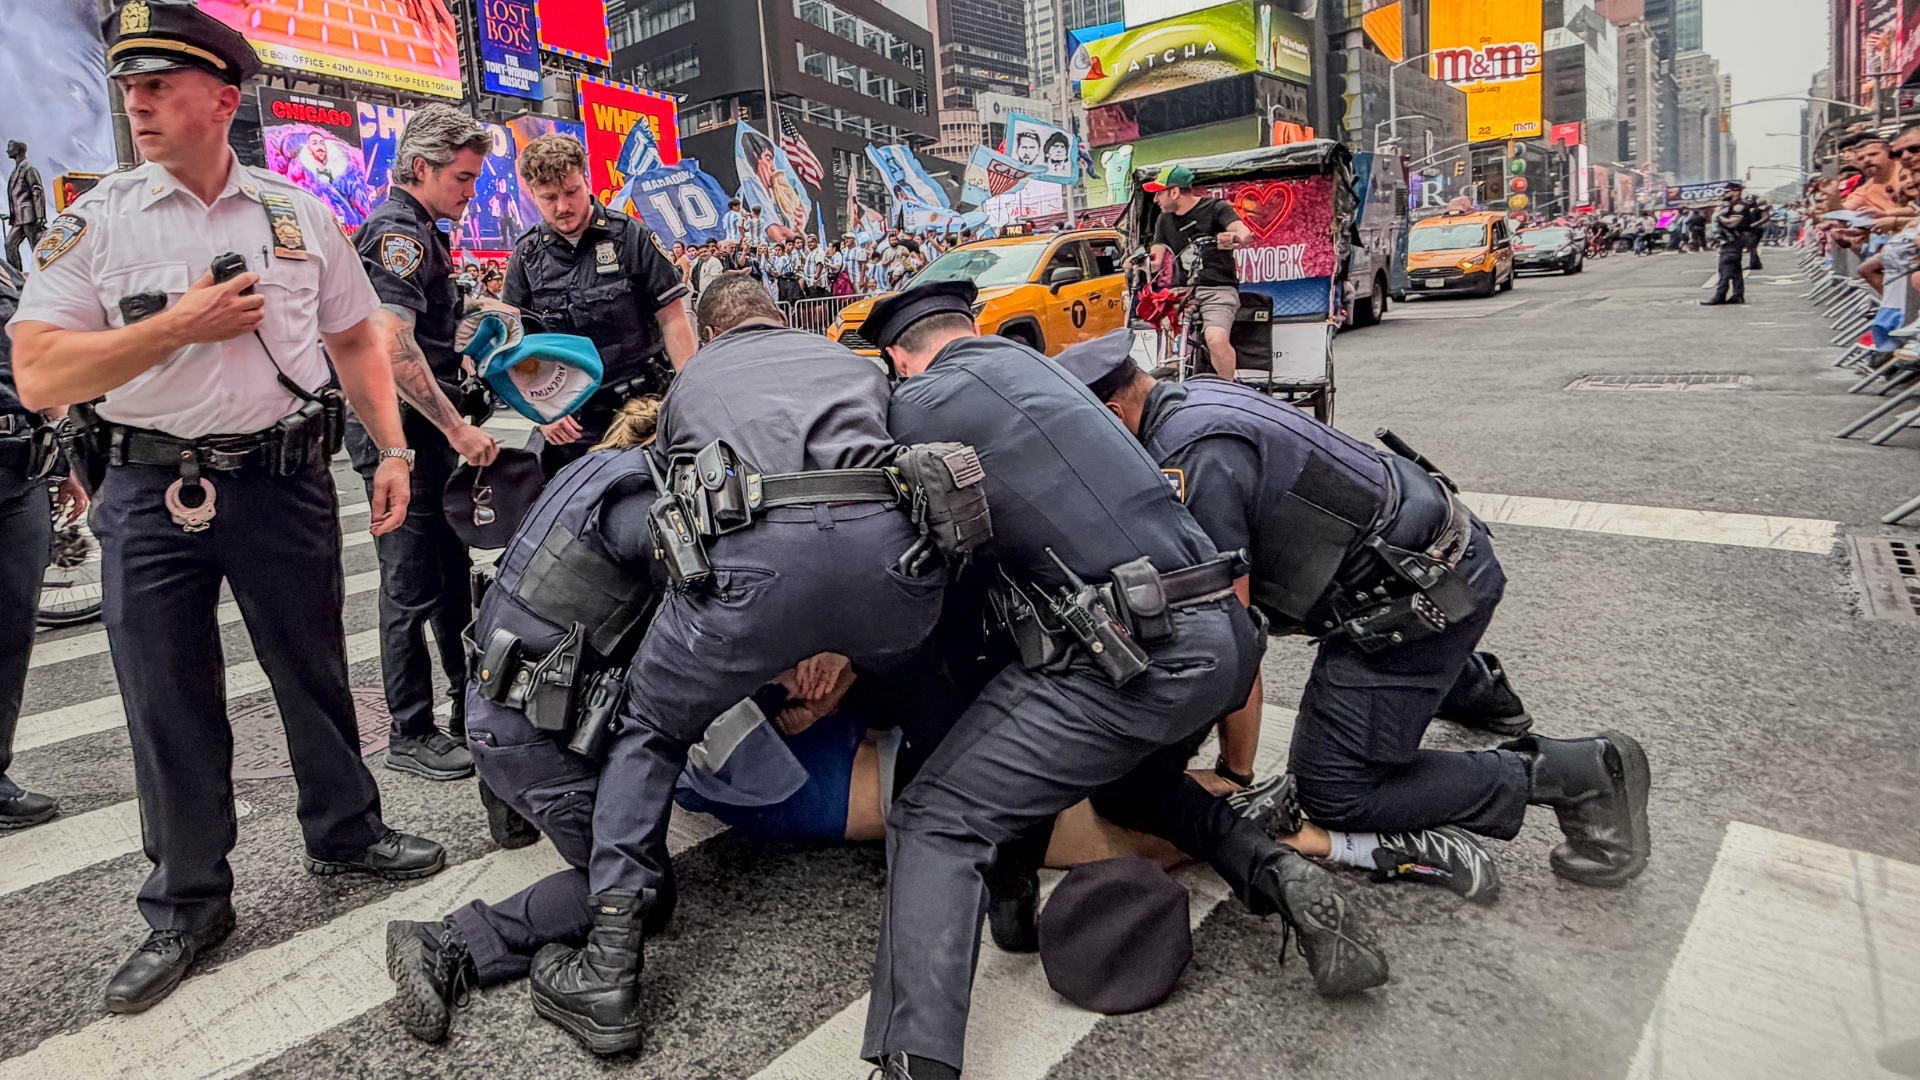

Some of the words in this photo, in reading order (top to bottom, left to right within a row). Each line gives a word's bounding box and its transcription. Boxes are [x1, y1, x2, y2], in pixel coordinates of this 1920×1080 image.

[485, 0, 530, 31] LOST
[487, 19, 532, 50] BOYS
[270, 50, 289, 61] BOX
[292, 54, 325, 68] OFFICE
[332, 63, 354, 73] 42ND
[356, 67, 374, 77] AND
[394, 74, 411, 83] SKIP
[412, 78, 430, 88] FEES
[485, 60, 539, 82] TONY-WINNING
[504, 53, 519, 67] THE
[1111, 39, 1217, 76] TATCHA
[498, 74, 530, 91] MUSICAL
[271, 99, 353, 129] CHICAGO
[650, 183, 719, 239] 10
[1247, 243, 1307, 283] YORK
[529, 364, 566, 397] ARGENTINA
